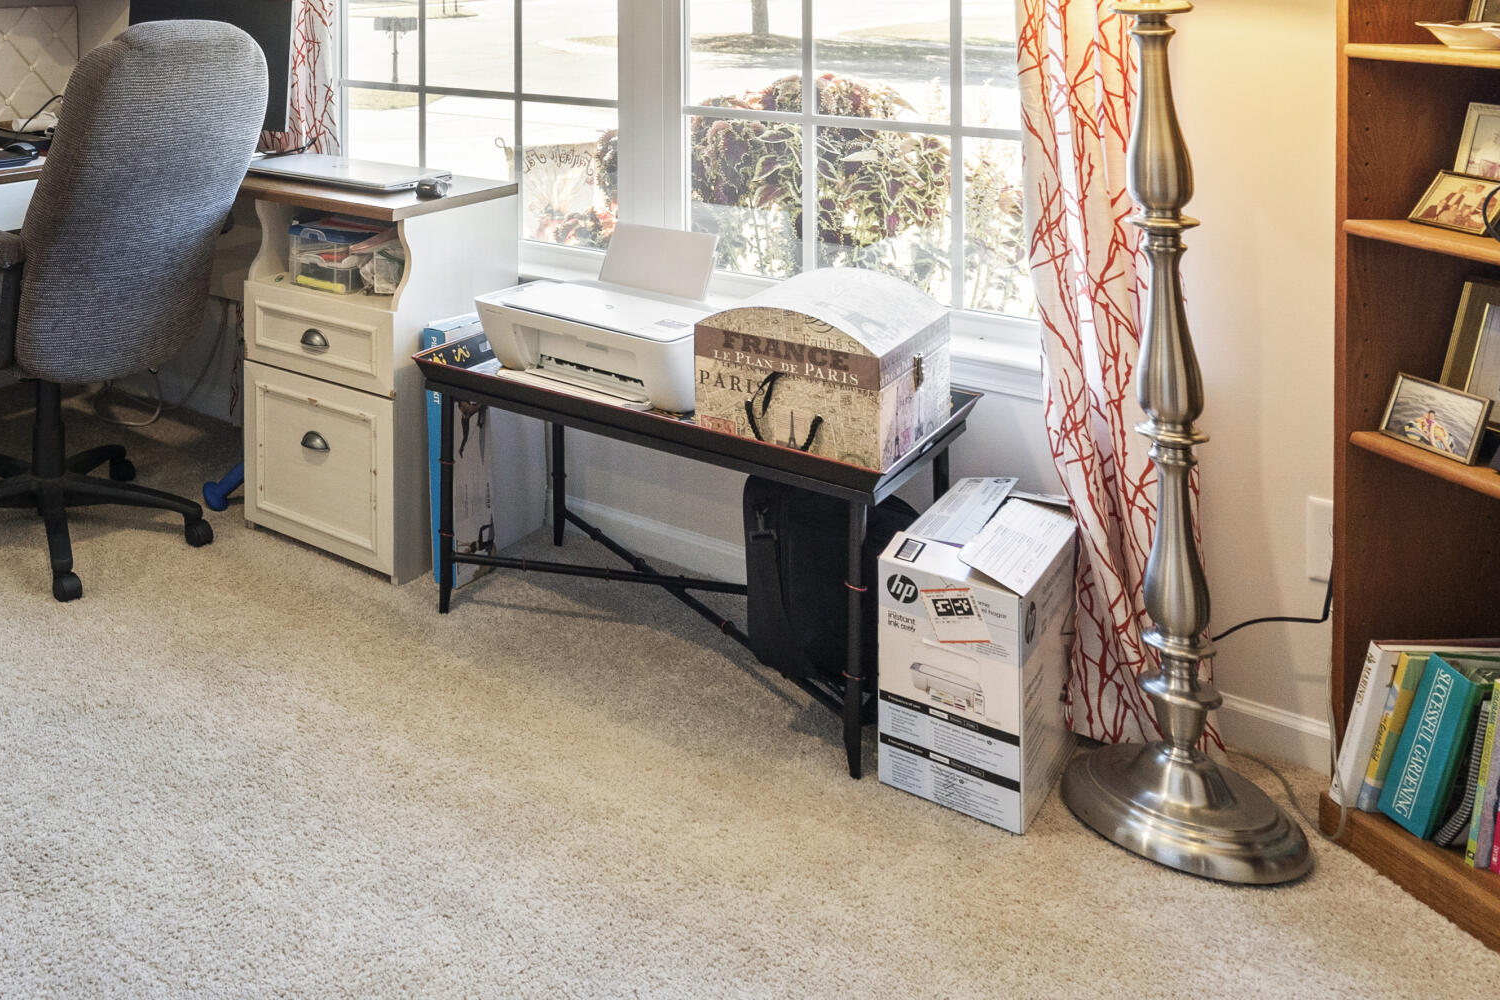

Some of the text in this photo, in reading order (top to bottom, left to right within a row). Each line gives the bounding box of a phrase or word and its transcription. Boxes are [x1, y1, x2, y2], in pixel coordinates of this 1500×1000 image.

[714, 349, 731, 361] LE
[735, 351, 774, 369] PLAN
[780, 362, 799, 375] DE
[804, 362, 859, 386] PARIS
[722, 330, 850, 371] FRANCE
[699, 369, 766, 397] PARIS
[888, 573, 917, 603] hp
[888, 612, 916, 625] instant
[1418, 669, 1452, 742] SUCCESSFUL
[1395, 744, 1428, 818] GARDENING
